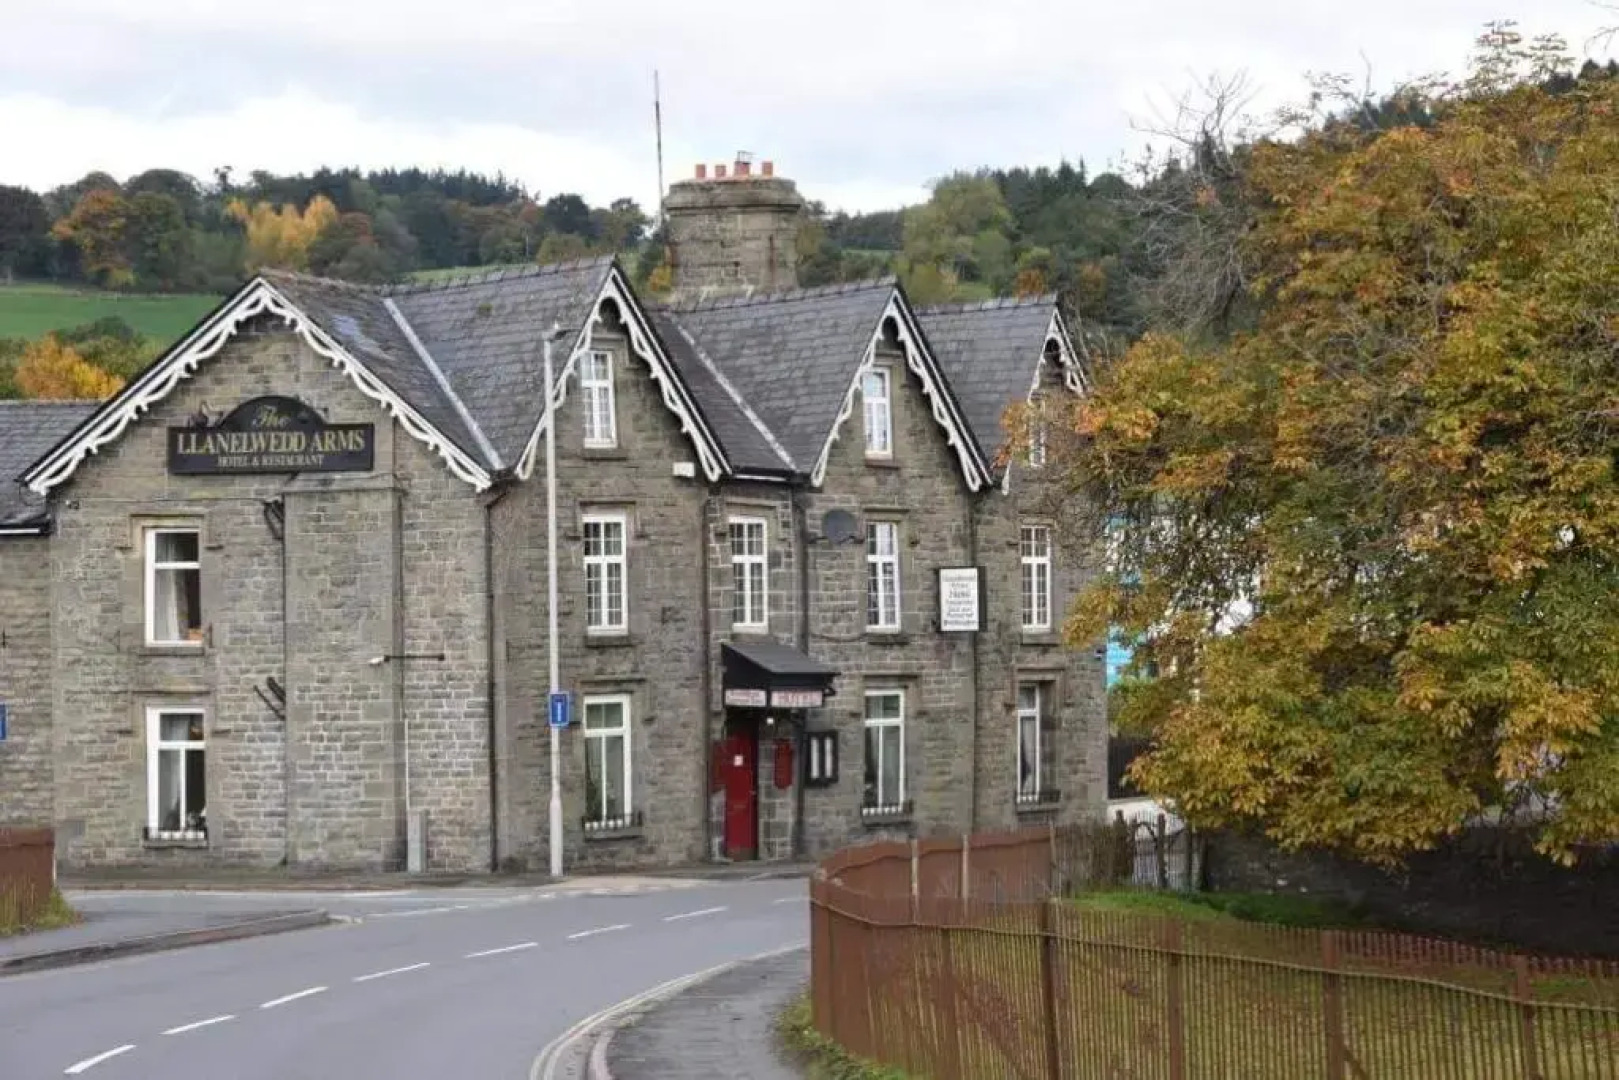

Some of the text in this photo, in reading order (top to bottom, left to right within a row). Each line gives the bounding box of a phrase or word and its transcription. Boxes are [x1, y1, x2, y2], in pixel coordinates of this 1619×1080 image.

[252, 405, 291, 427] The
[177, 429, 366, 455] LLANELWEDD ARMS
[217, 454, 325, 467] HOTEL & RESTAURANT
